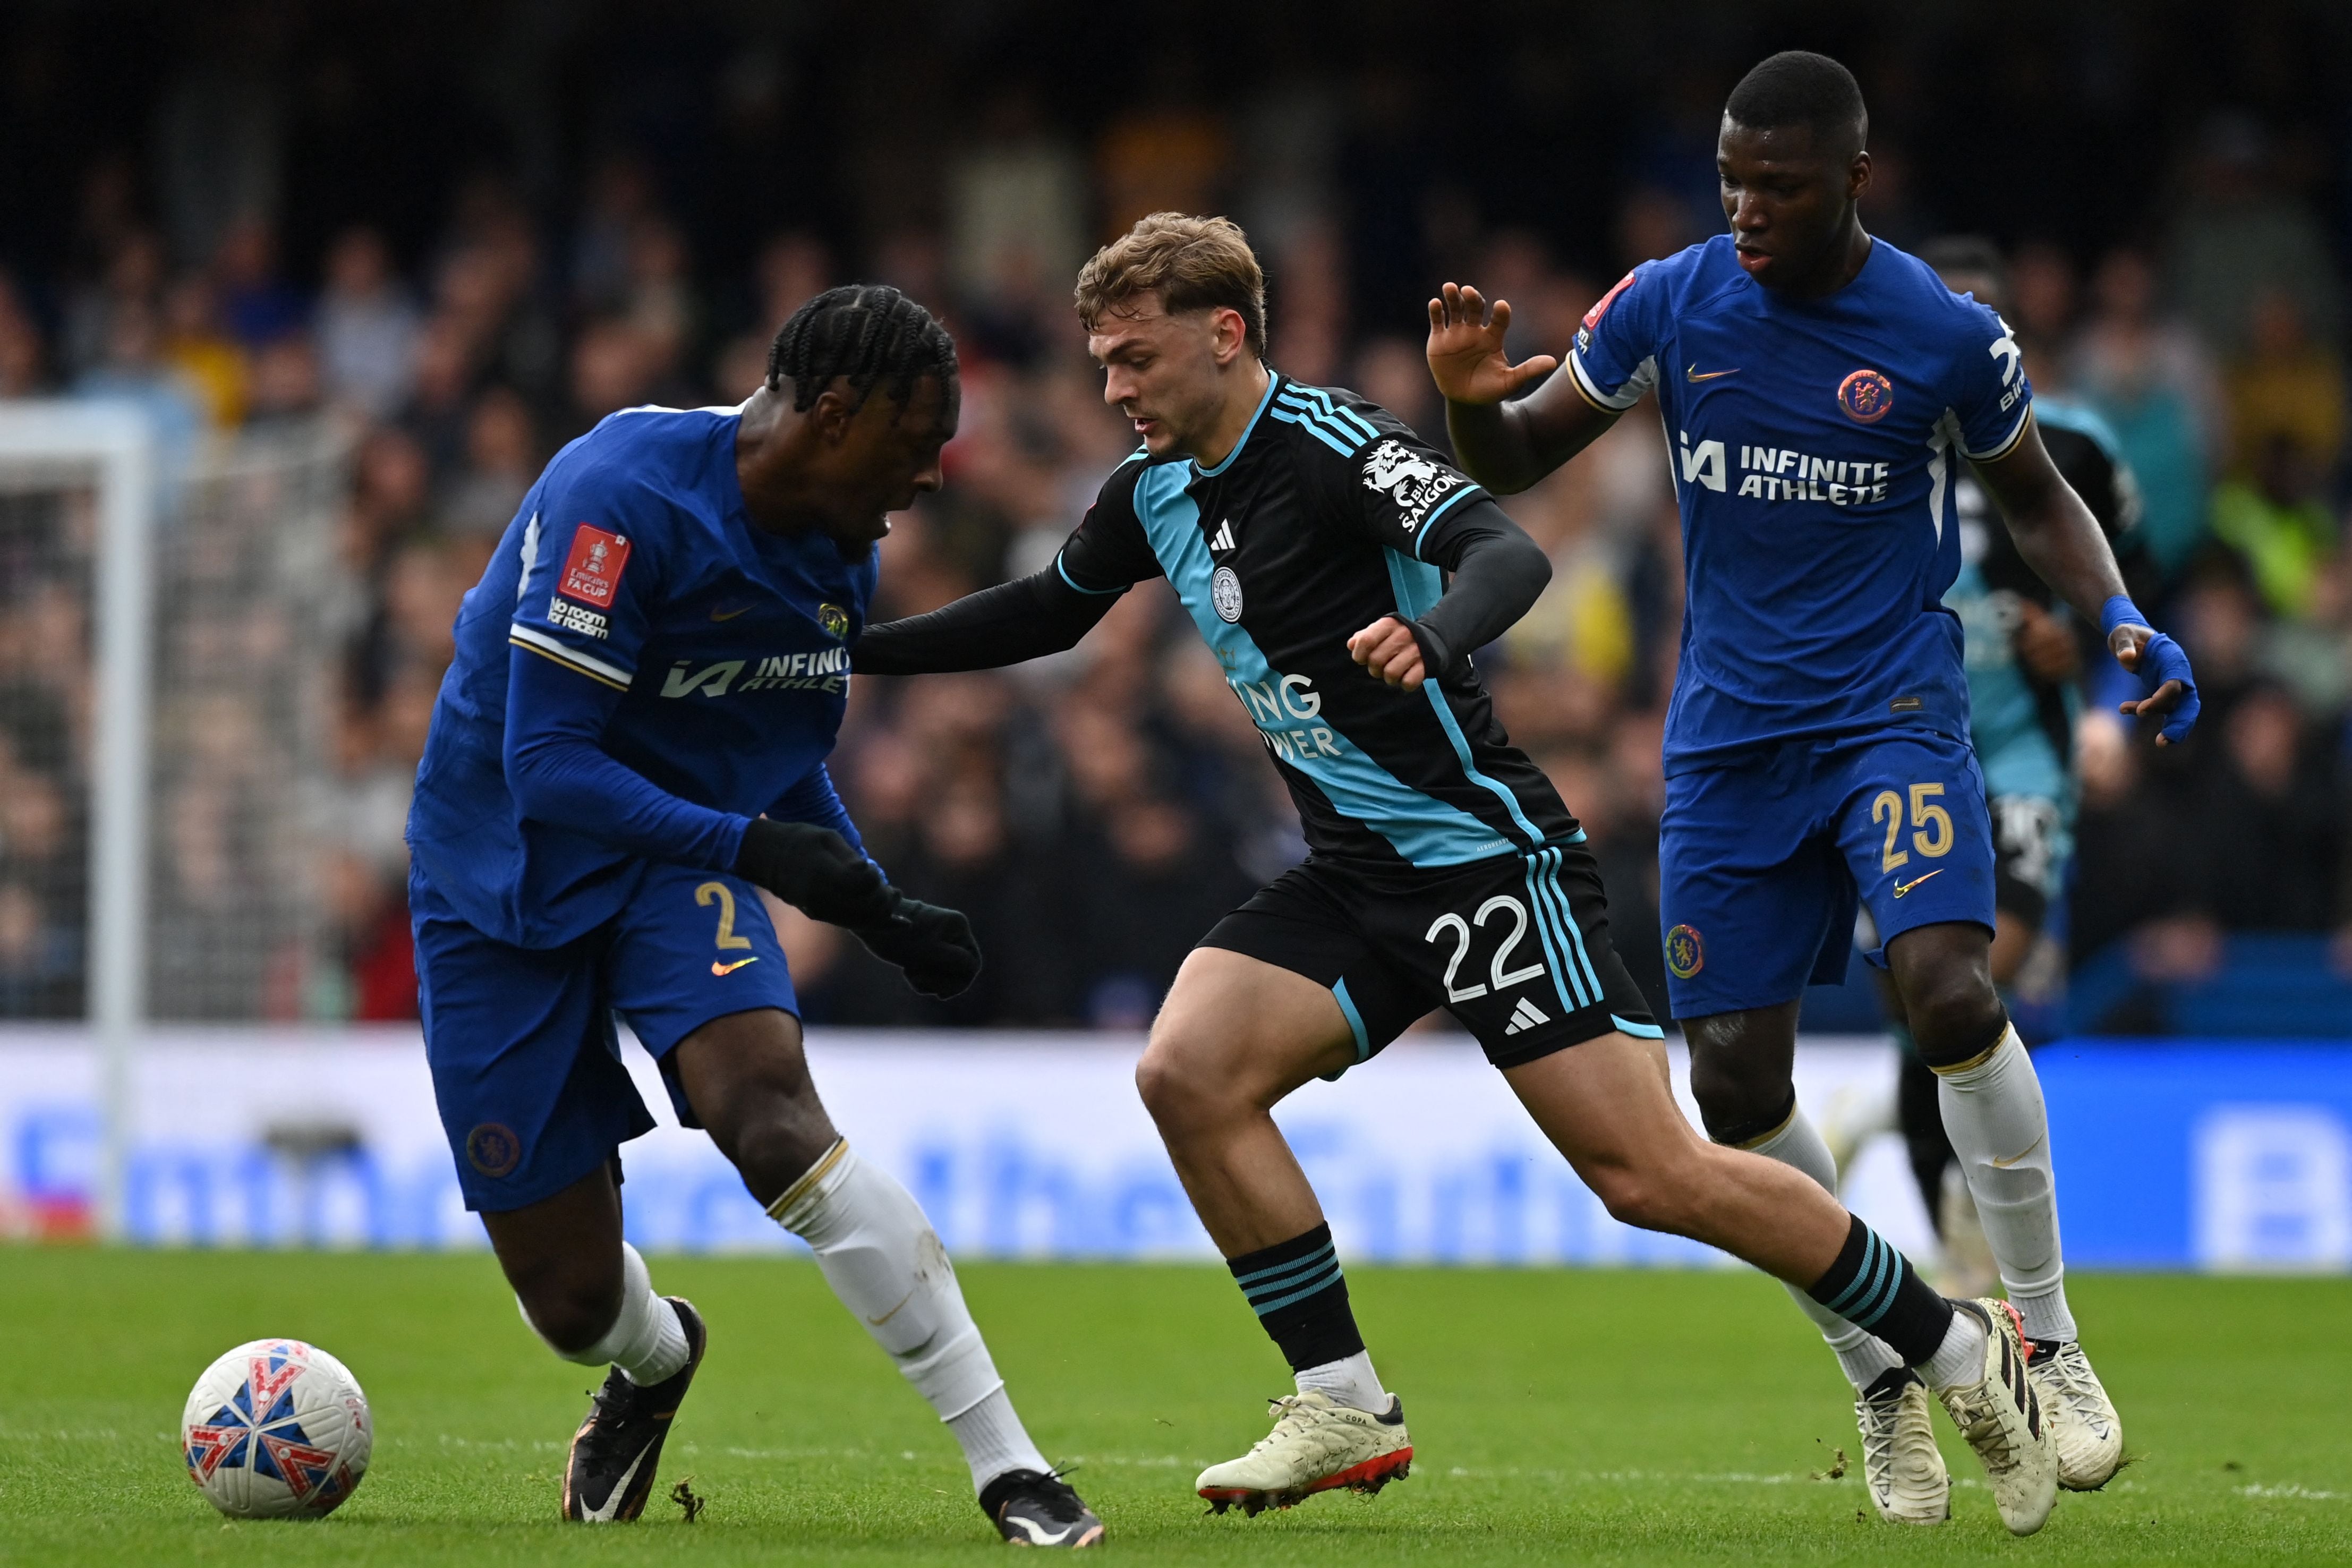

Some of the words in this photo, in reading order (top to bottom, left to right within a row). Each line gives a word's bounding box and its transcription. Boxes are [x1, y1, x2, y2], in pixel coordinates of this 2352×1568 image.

[1741, 446, 1889, 485] INFINITE
[1410, 478, 1431, 501] BIA
[1737, 475, 1888, 506] ATHLETE
[1402, 474, 1464, 533] SAIGON
[567, 577, 581, 590] FA
[582, 583, 608, 598] CUP
[1215, 572, 1231, 593] LEICESTER
[563, 616, 608, 640] racism
[567, 606, 606, 627] room
[1226, 674, 1321, 721] ING
[1872, 782, 1954, 874] 25
[1477, 837, 1510, 853] AEROREADY
[695, 881, 752, 950] 2
[1425, 895, 1546, 1003] 22
[1345, 1414, 1367, 1425] COPA
